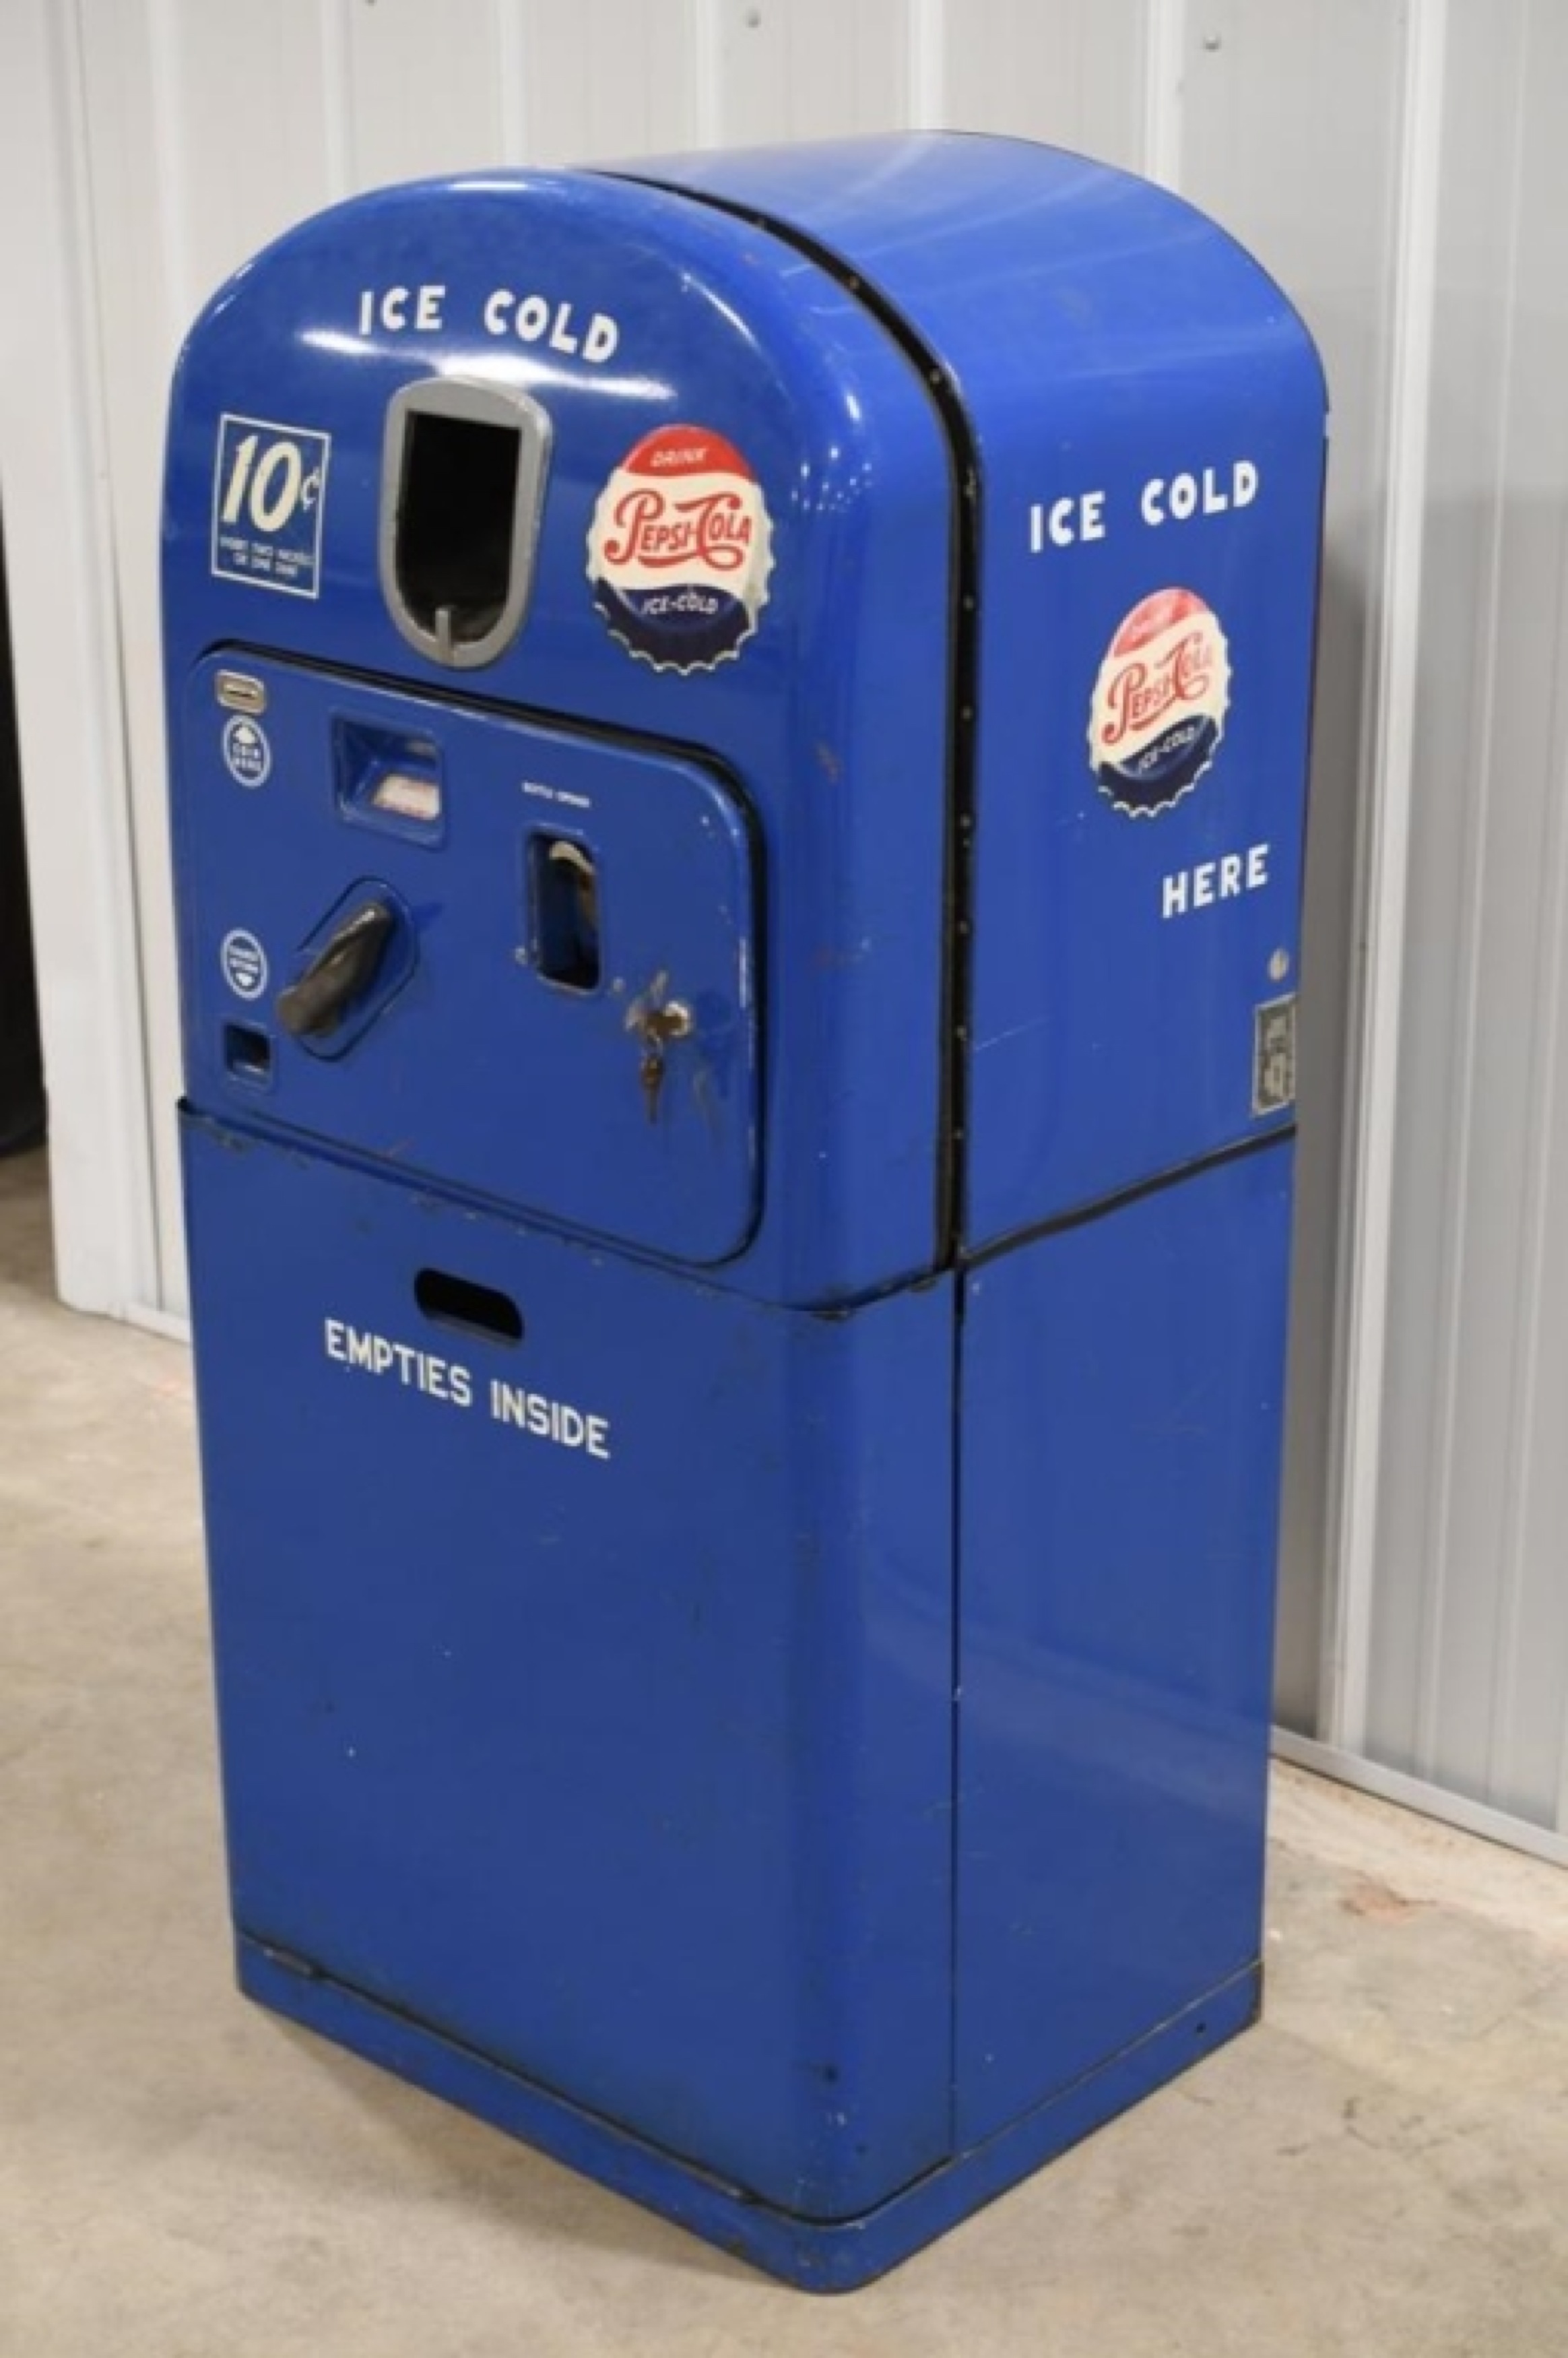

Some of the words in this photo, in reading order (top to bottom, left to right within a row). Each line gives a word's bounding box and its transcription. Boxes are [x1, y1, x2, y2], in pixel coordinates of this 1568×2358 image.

[359, 285, 446, 336] ICE
[484, 288, 619, 363] COLD
[650, 448, 708, 468] DRINK
[1030, 490, 1107, 554] ICE
[1141, 459, 1260, 526] COLD
[643, 592, 719, 616] ICE-COLD
[1163, 843, 1269, 919] HERE
[325, 1317, 472, 1407] EMPTIES
[490, 1379, 611, 1461] INSIDE
